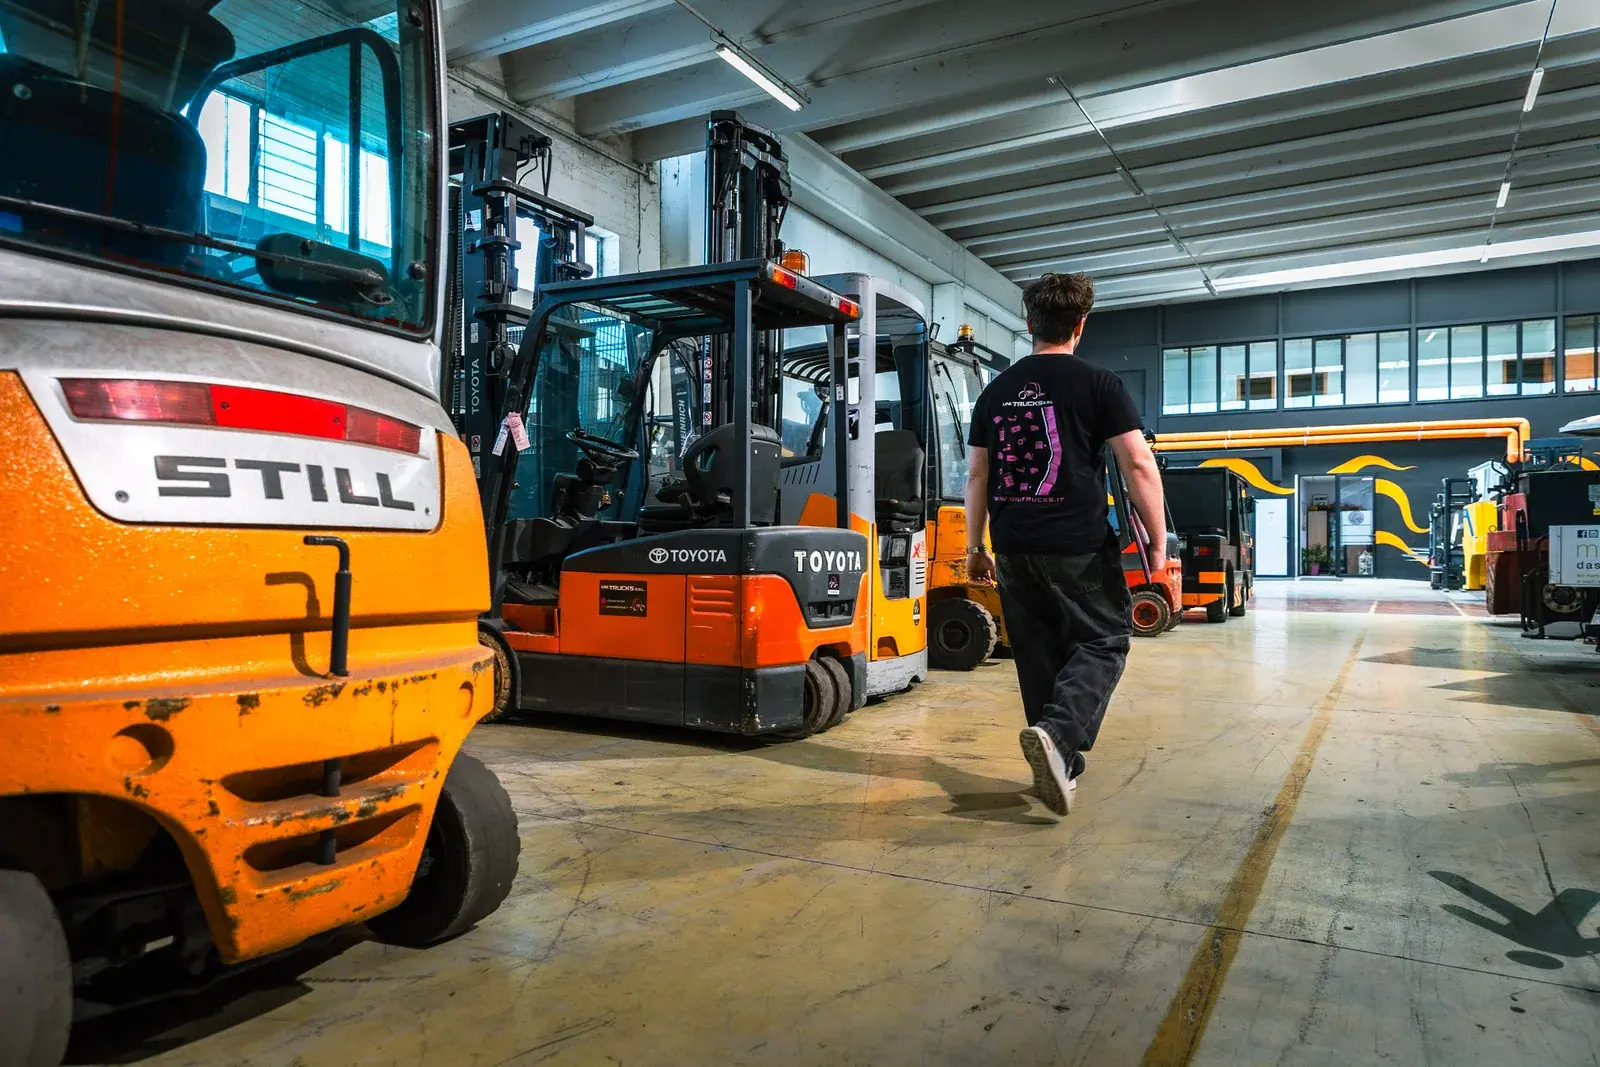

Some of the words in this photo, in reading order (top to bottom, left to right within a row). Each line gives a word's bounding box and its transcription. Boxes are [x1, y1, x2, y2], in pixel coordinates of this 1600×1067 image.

[471, 358, 480, 416] TOYOTA
[154, 454, 416, 512] STILL
[671, 549, 727, 562] TOYOTA
[793, 550, 862, 573] TOYOTA
